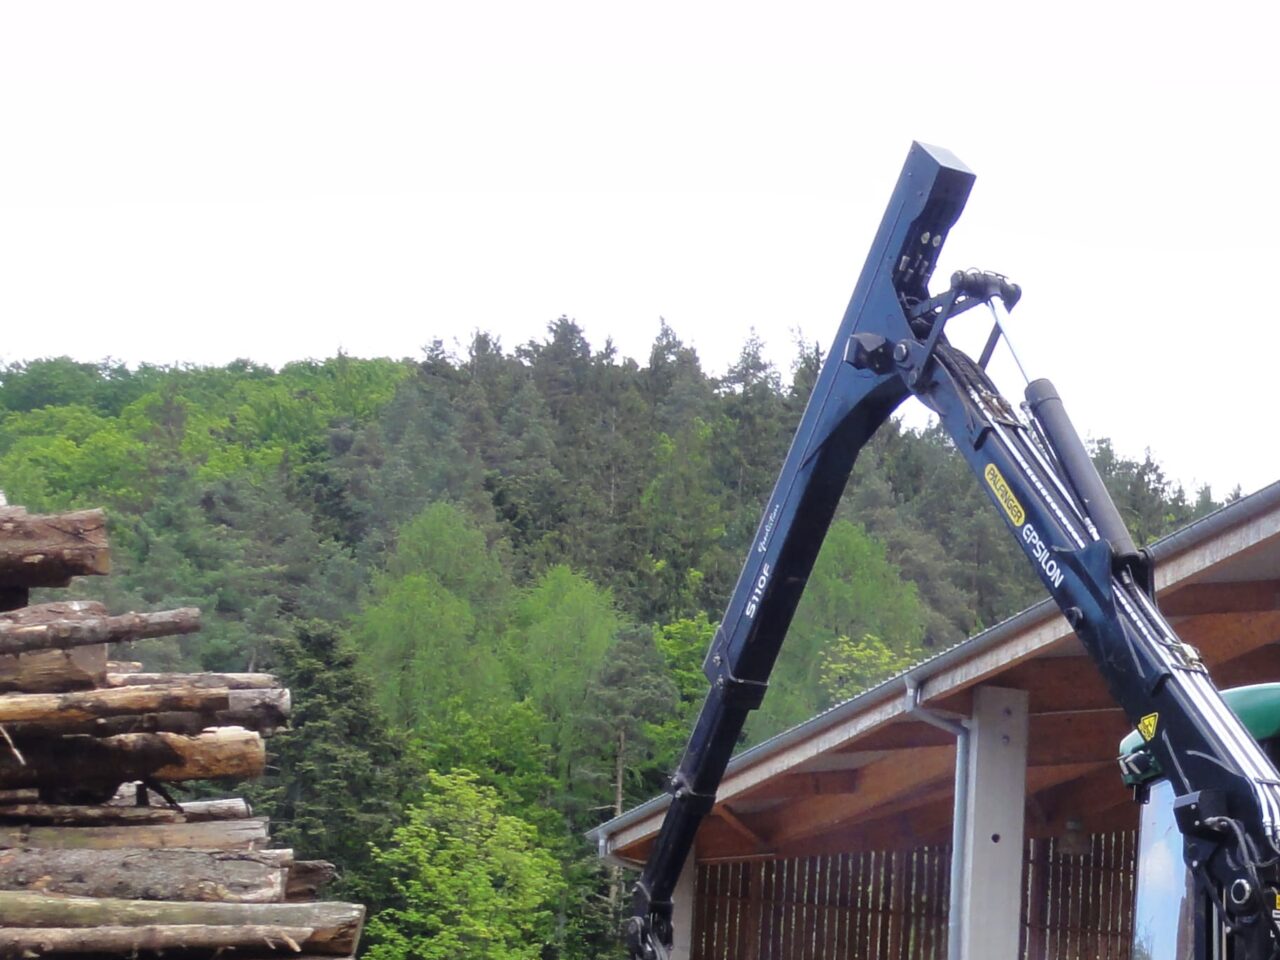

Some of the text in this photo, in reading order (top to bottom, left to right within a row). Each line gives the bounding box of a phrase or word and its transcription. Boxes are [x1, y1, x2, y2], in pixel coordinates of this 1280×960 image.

[986, 466, 1065, 589] PALFINGER EPSILON
[745, 562, 770, 619] S110F
